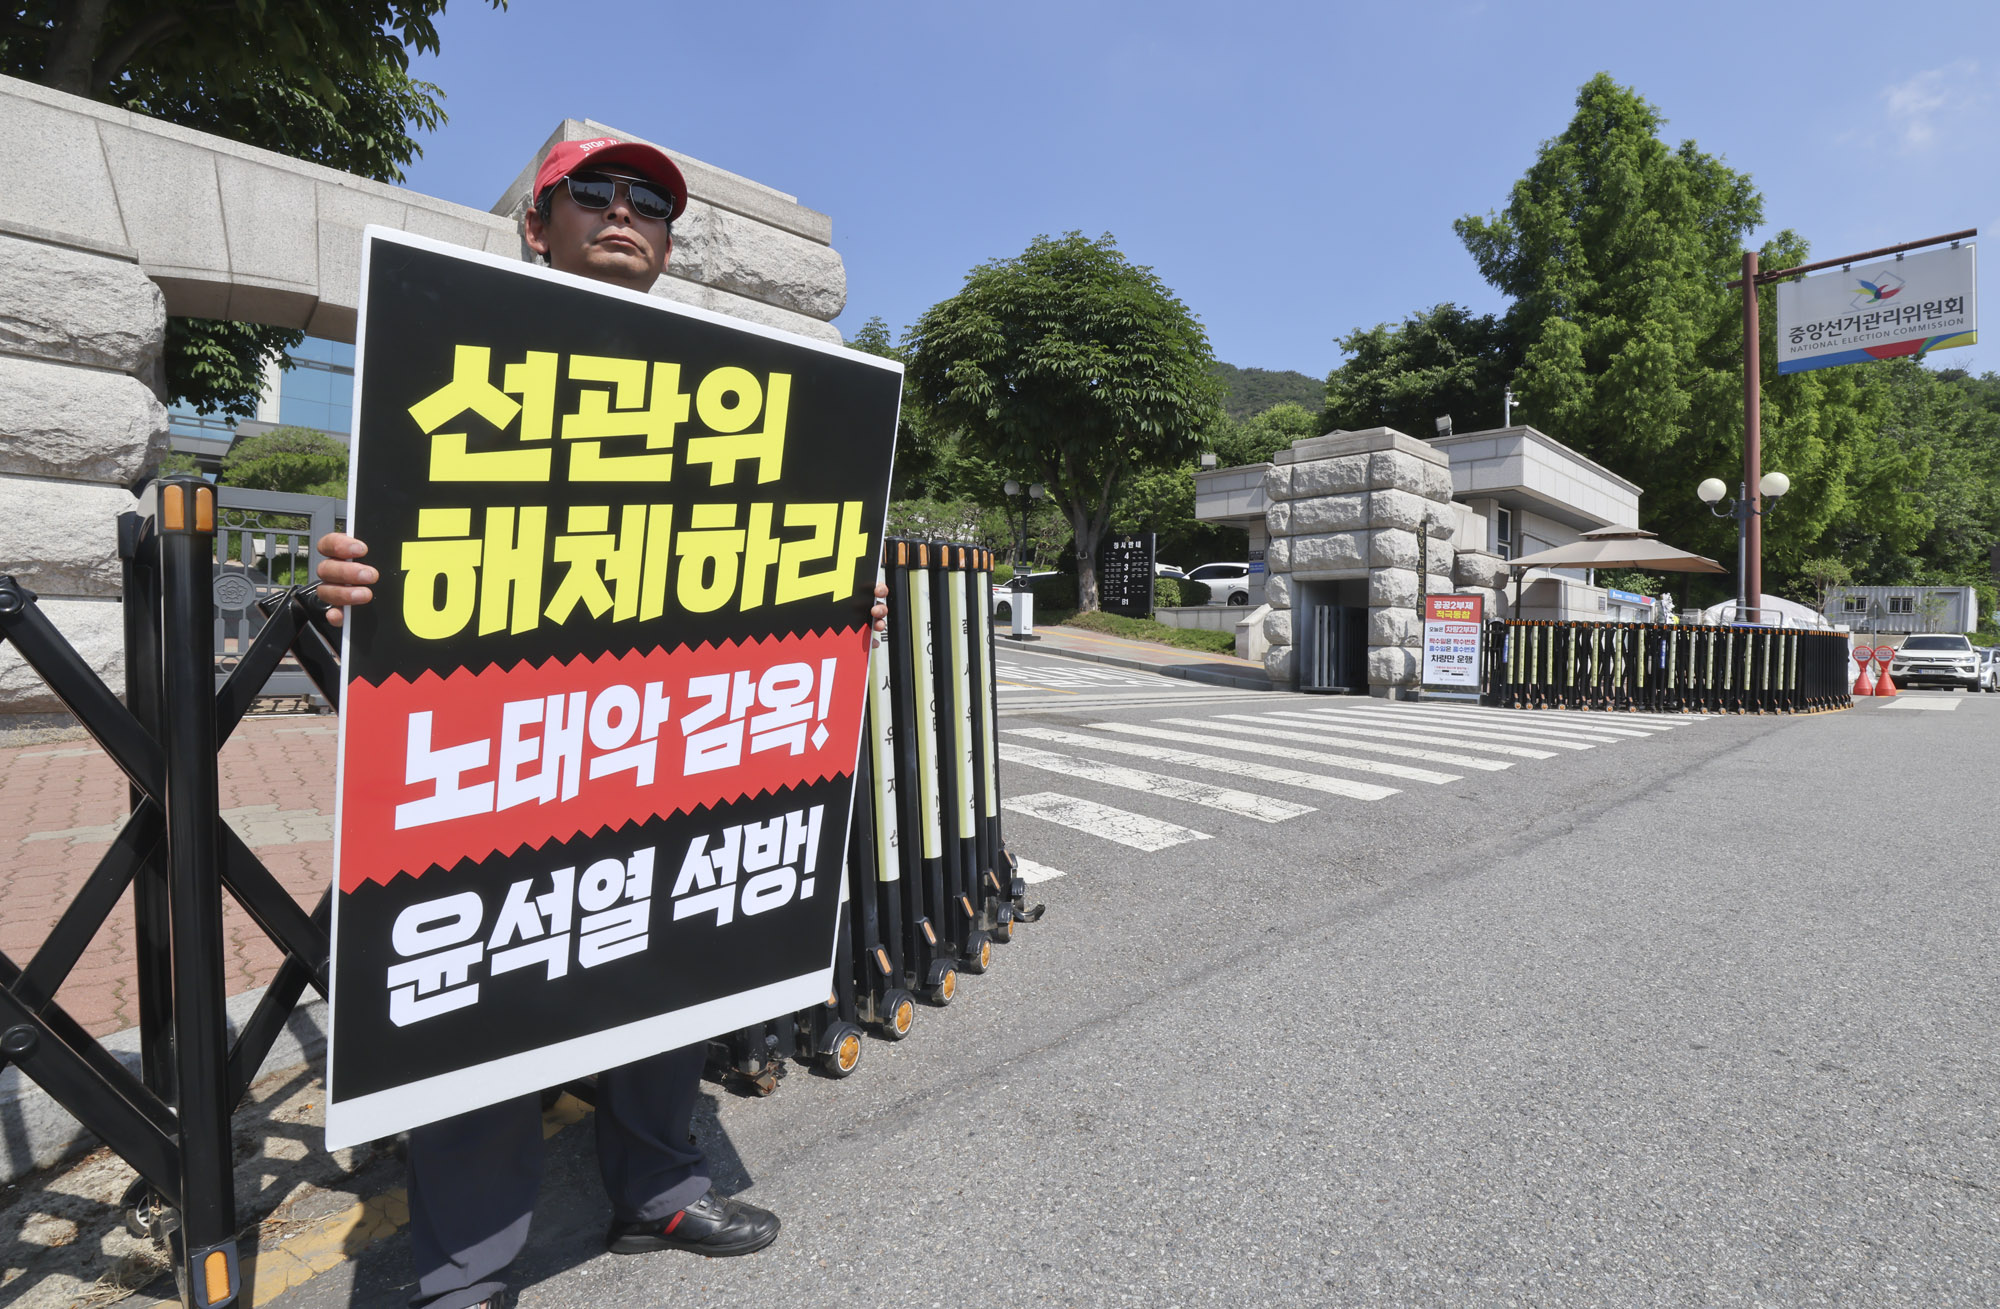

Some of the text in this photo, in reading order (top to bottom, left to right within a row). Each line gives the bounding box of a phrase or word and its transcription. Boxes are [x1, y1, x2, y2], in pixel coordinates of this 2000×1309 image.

[580, 140, 605, 151] STOP
[1789, 296, 1964, 344] 중앙선거관리위원회
[1790, 317, 1964, 353] NATIONAL ELECTION COMMISSION
[408, 345, 791, 486] 선관위
[1123, 563, 1129, 571] 3
[1124, 552, 1129, 560] 4
[401, 502, 868, 639] 해체하라
[1123, 575, 1129, 583] 2
[1433, 600, 1474, 610] 공공2부제
[1431, 654, 1473, 664] 차량만 운행
[395, 682, 670, 830] 노태악
[681, 658, 836, 776] 감옥!
[388, 805, 824, 1026] 윤석열 석방!
